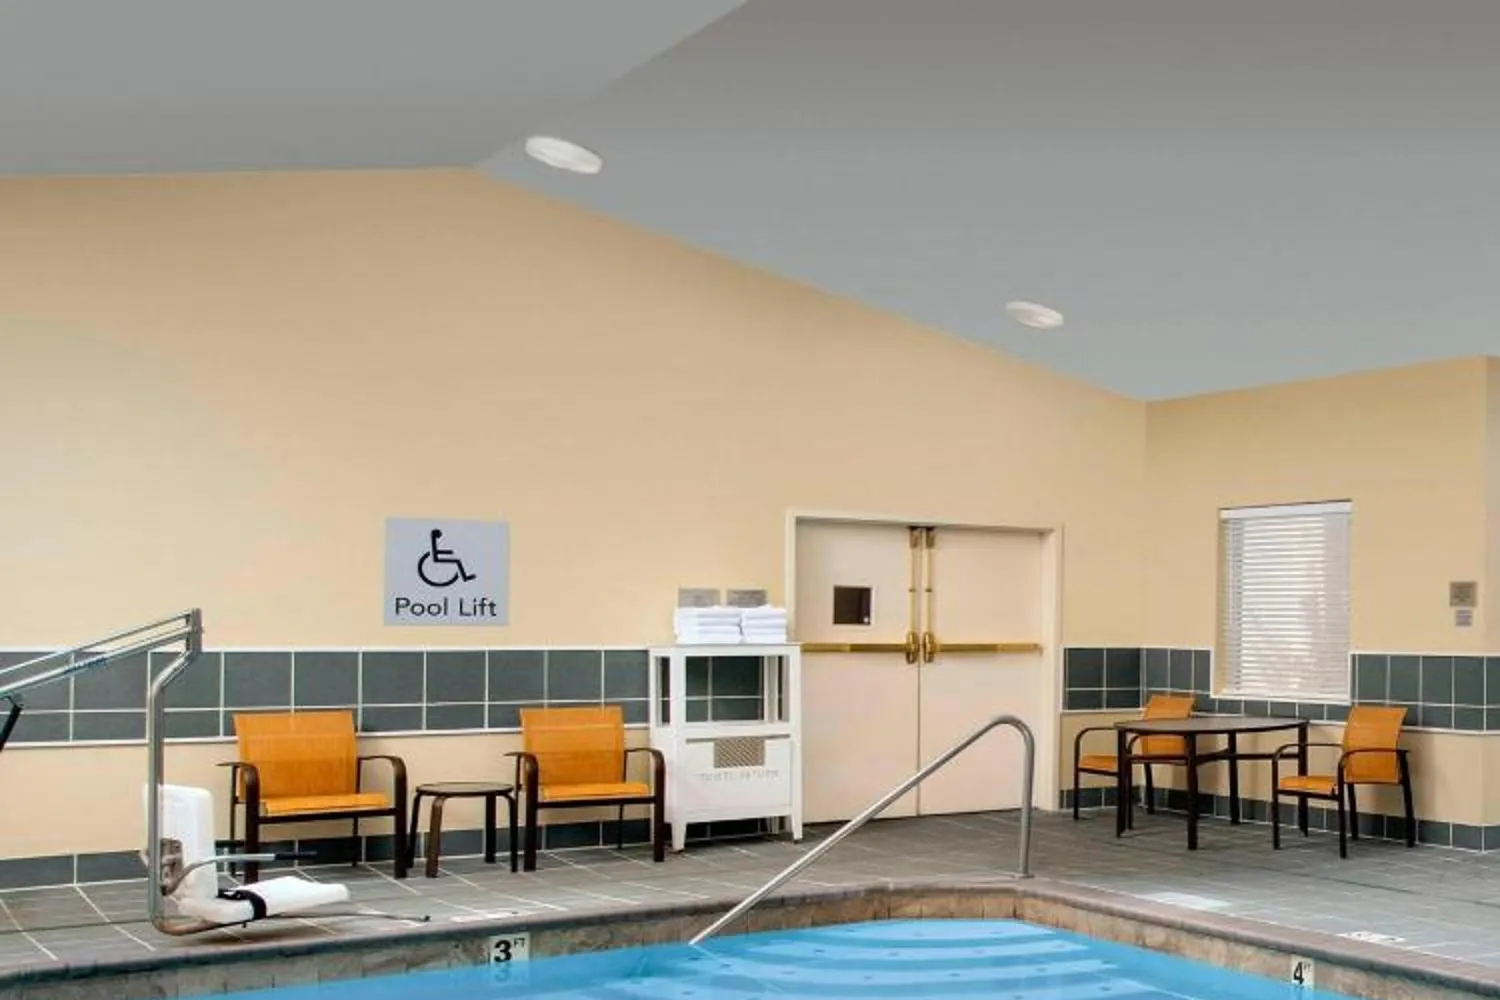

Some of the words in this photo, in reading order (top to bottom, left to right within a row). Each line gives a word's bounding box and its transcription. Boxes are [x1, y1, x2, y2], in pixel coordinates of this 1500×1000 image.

[395, 597, 448, 616] Pool
[459, 597, 497, 617] Lift
[494, 940, 512, 963] 3
[1294, 961, 1304, 985] 4
